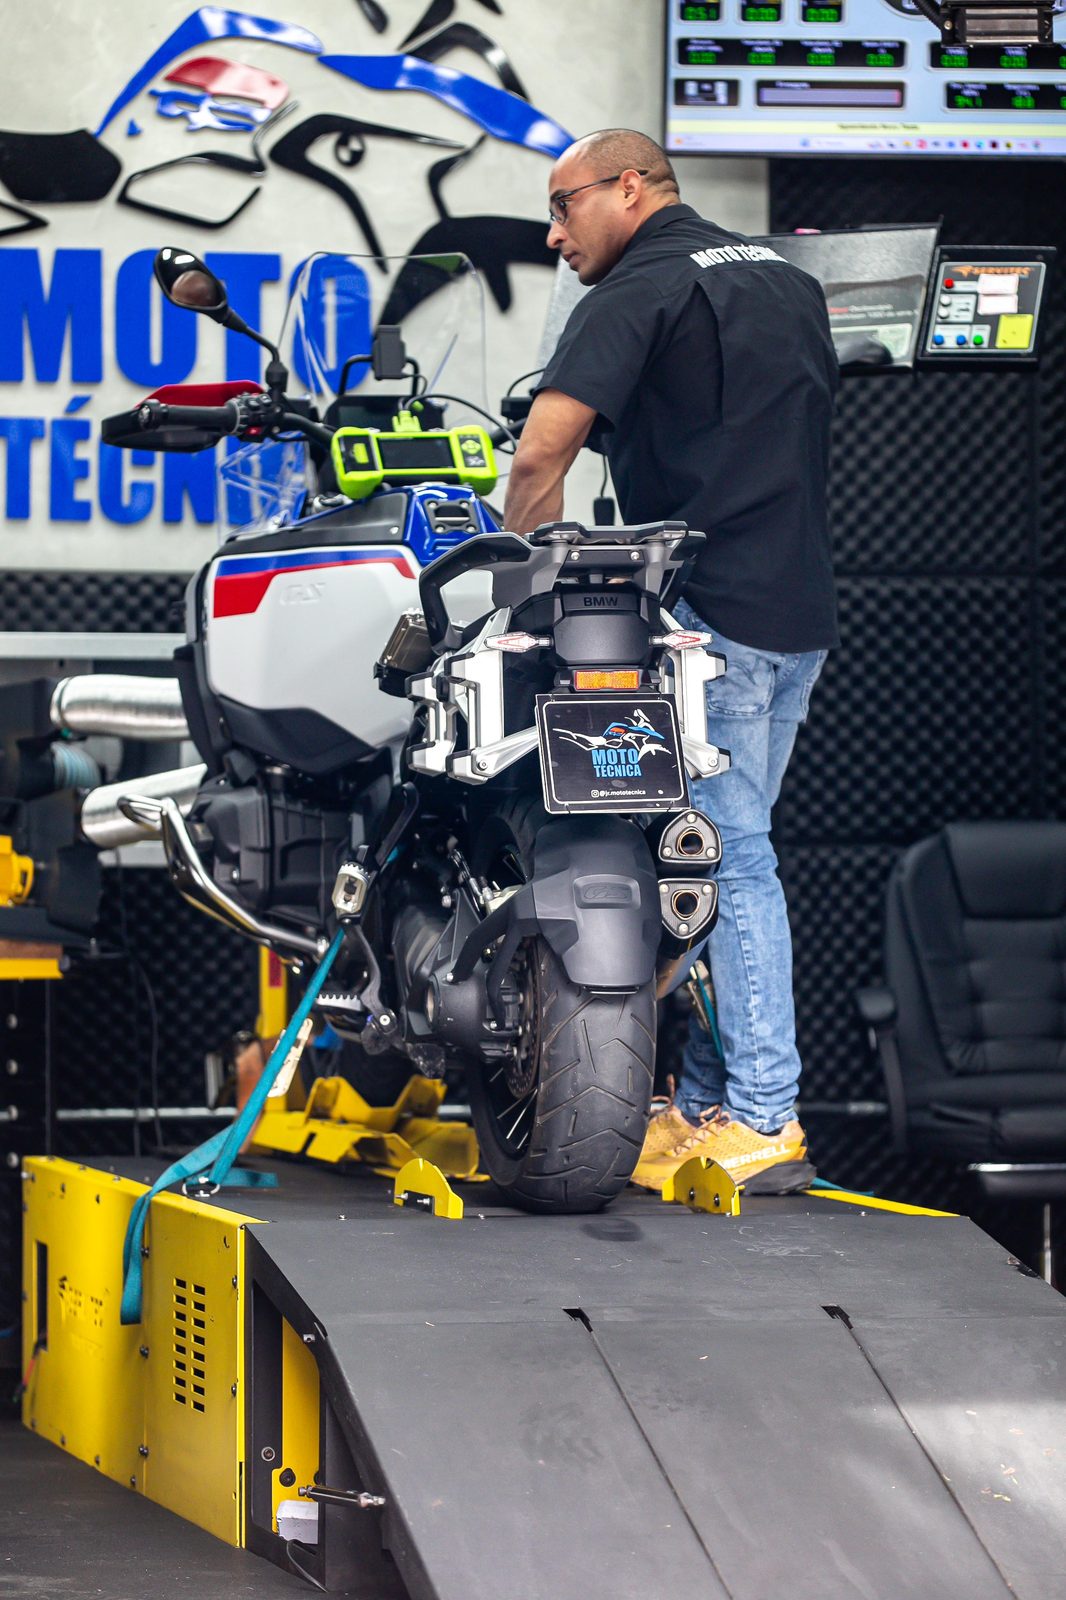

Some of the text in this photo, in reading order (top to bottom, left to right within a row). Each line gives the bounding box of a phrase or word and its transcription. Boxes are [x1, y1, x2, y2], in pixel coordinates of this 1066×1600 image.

[689, 245, 743, 268] MOTO
[0, 247, 372, 396] MOTO
[583, 596, 618, 607] BMW
[591, 747, 640, 765] MOTO
[594, 763, 642, 778] TECNICA
[723, 1143, 792, 1169] MERRELL
